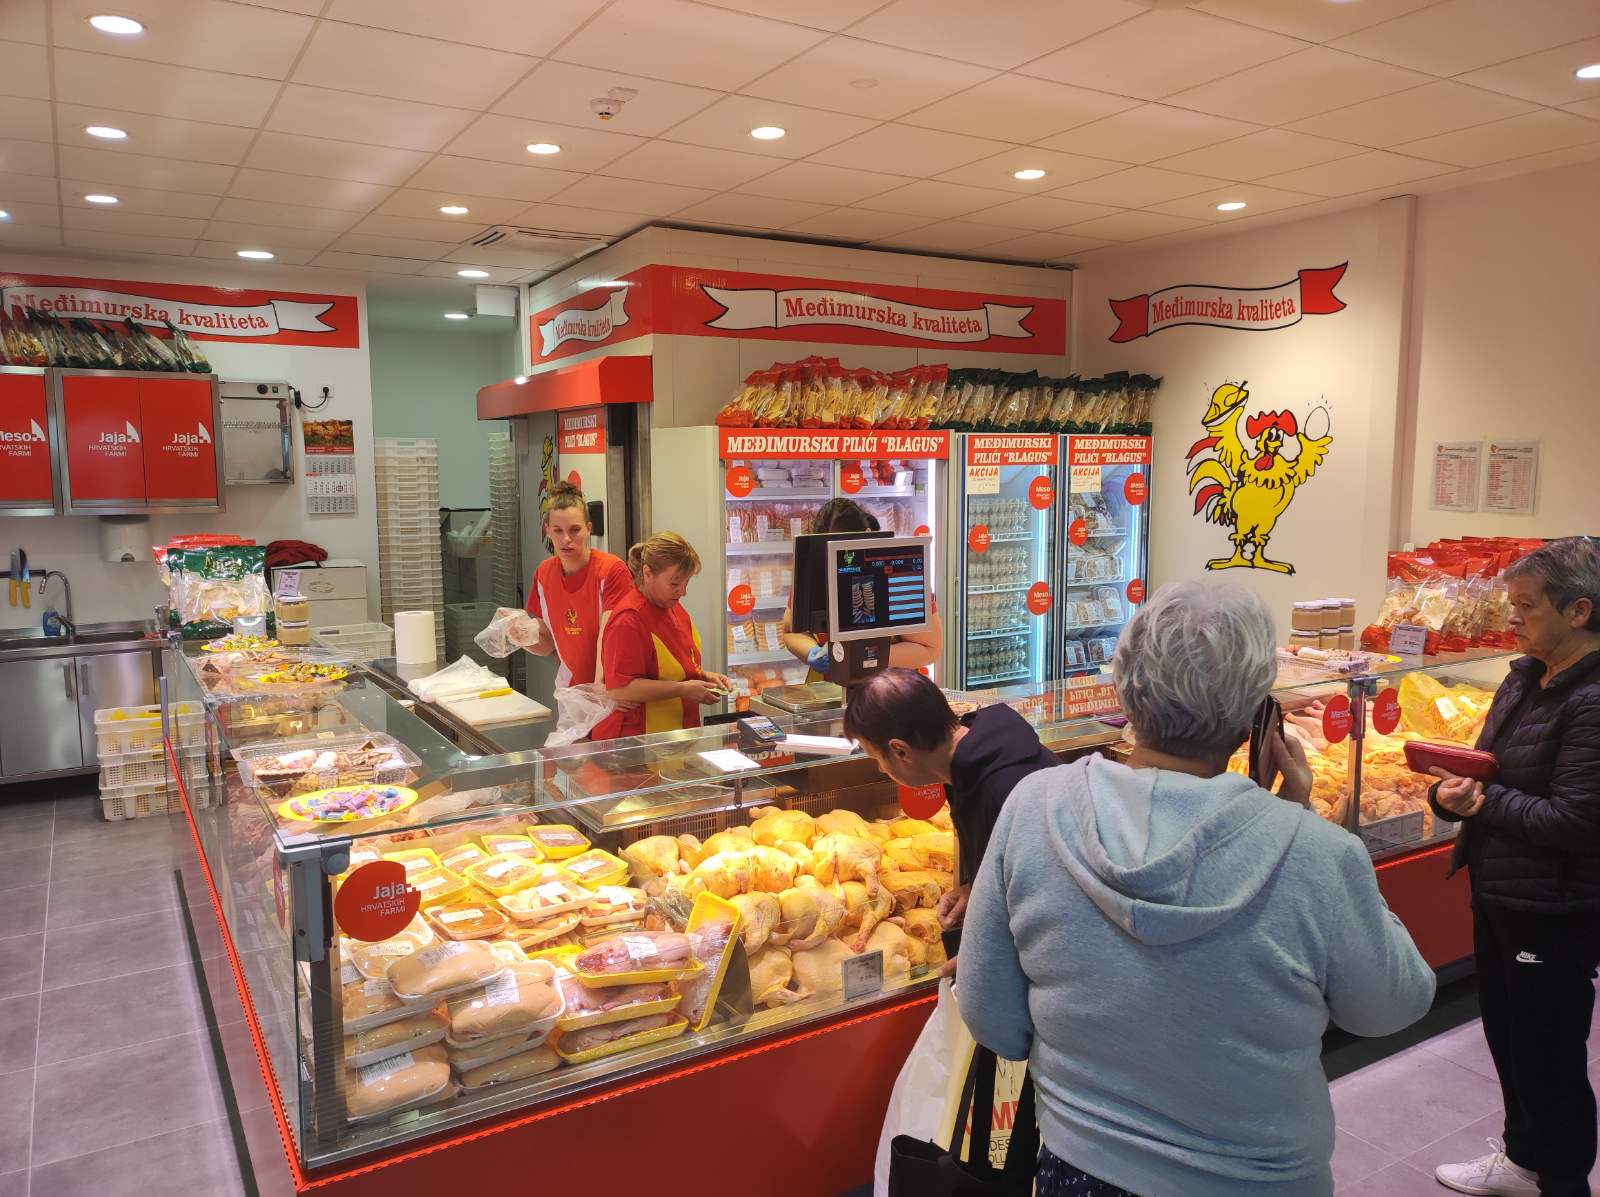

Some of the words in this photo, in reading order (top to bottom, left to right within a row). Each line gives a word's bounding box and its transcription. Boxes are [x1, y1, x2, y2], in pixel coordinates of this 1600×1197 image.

[784, 297, 907, 328] Međimurska
[912, 312, 982, 334] kvaliteta
[1152, 296, 1233, 324] Međimurska
[1236, 296, 1296, 321] kvaliteta
[178, 308, 269, 329] kvaliteta
[99, 432, 127, 445] Jaja
[172, 433, 199, 445] Jaja
[727, 436, 839, 453] MEĐIMURSKI
[842, 431, 877, 453] PILIĆI
[974, 437, 1053, 449] MEĐIMURSKI
[1074, 439, 1147, 450] MEĐIMURSKI
[973, 449, 1001, 464] PILIĆI
[1073, 450, 1099, 464] PILIĆI
[968, 467, 998, 478] AKCIJA
[1072, 467, 1100, 477] AKCIJA
[372, 881, 406, 899] Jaja
[361, 898, 405, 912] HRVATSKIH
[380, 906, 406, 917] FARMI
